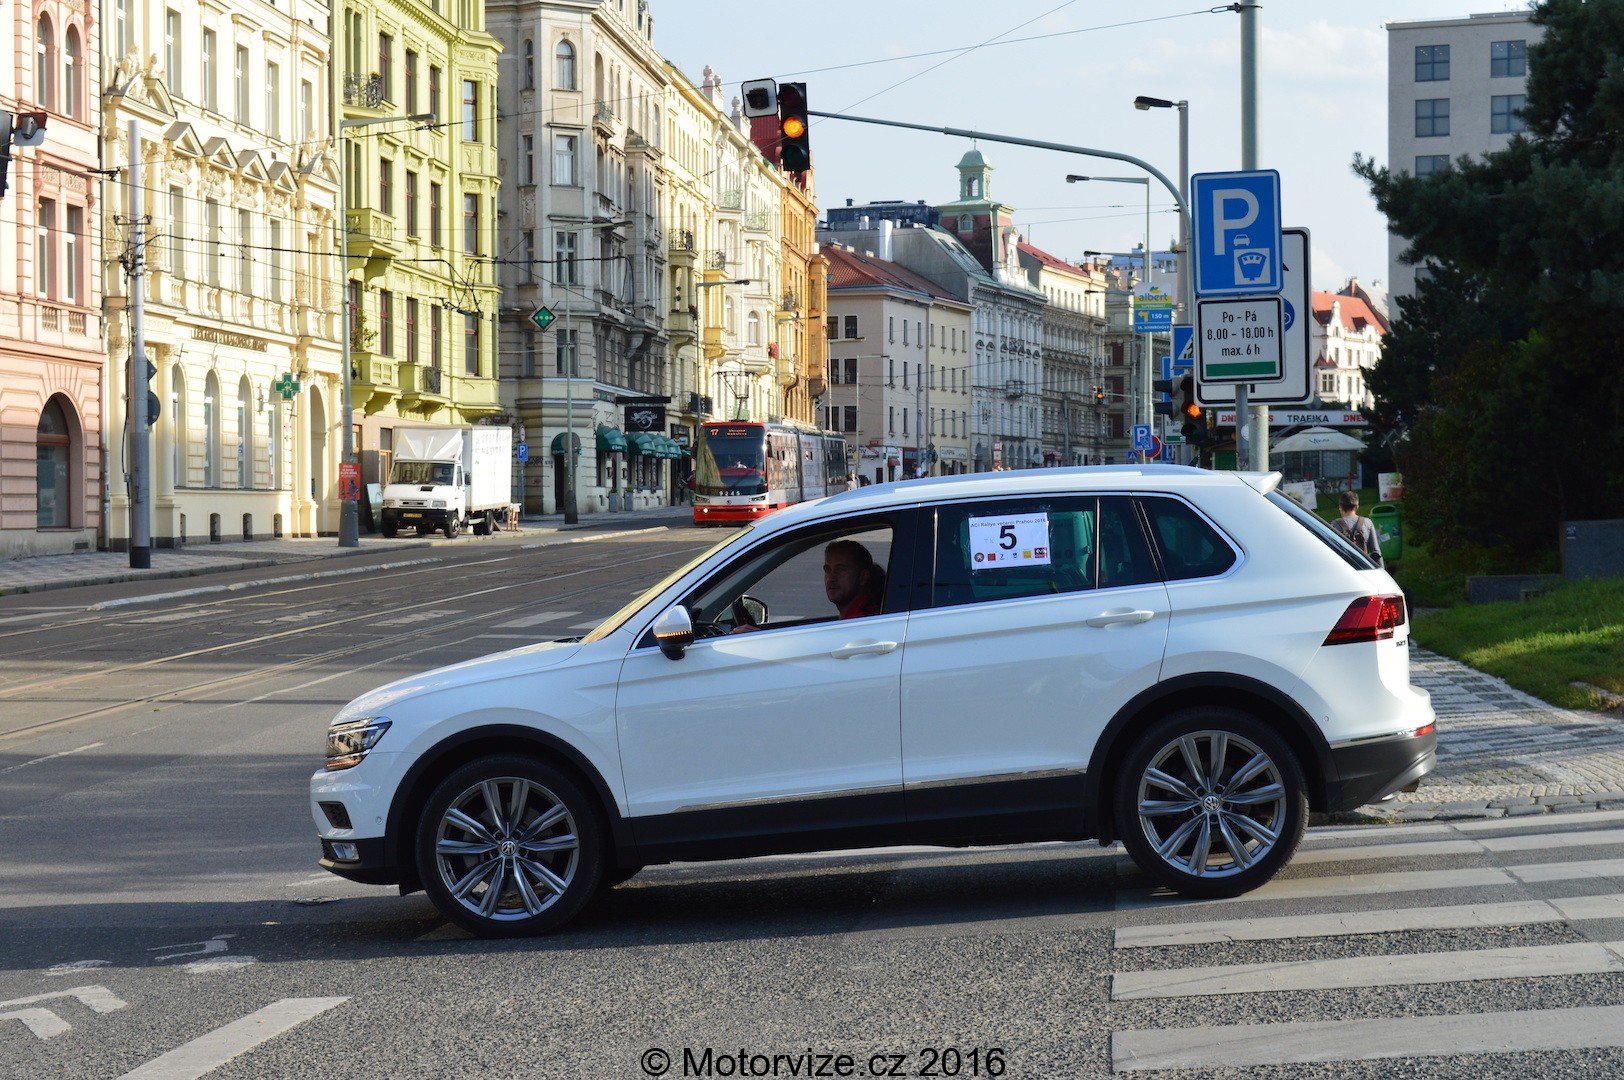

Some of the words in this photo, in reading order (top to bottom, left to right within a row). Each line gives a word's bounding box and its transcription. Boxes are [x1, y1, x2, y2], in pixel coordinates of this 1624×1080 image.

[1212, 188, 1260, 256] P
[1139, 293, 1168, 301] albert
[1222, 311, 1234, 323] Po
[1245, 310, 1257, 322] Pá
[1207, 328, 1228, 341] 8.00
[1240, 326, 1265, 339] 18.00
[1268, 326, 1274, 338] h
[1222, 347, 1243, 356] max.
[1246, 344, 1252, 355] 6
[1254, 344, 1260, 354] h
[1287, 414, 1330, 422] TRAFIKA
[1136, 428, 1148, 442] P
[520, 445, 526, 456] P
[1000, 525, 1017, 550] 5
